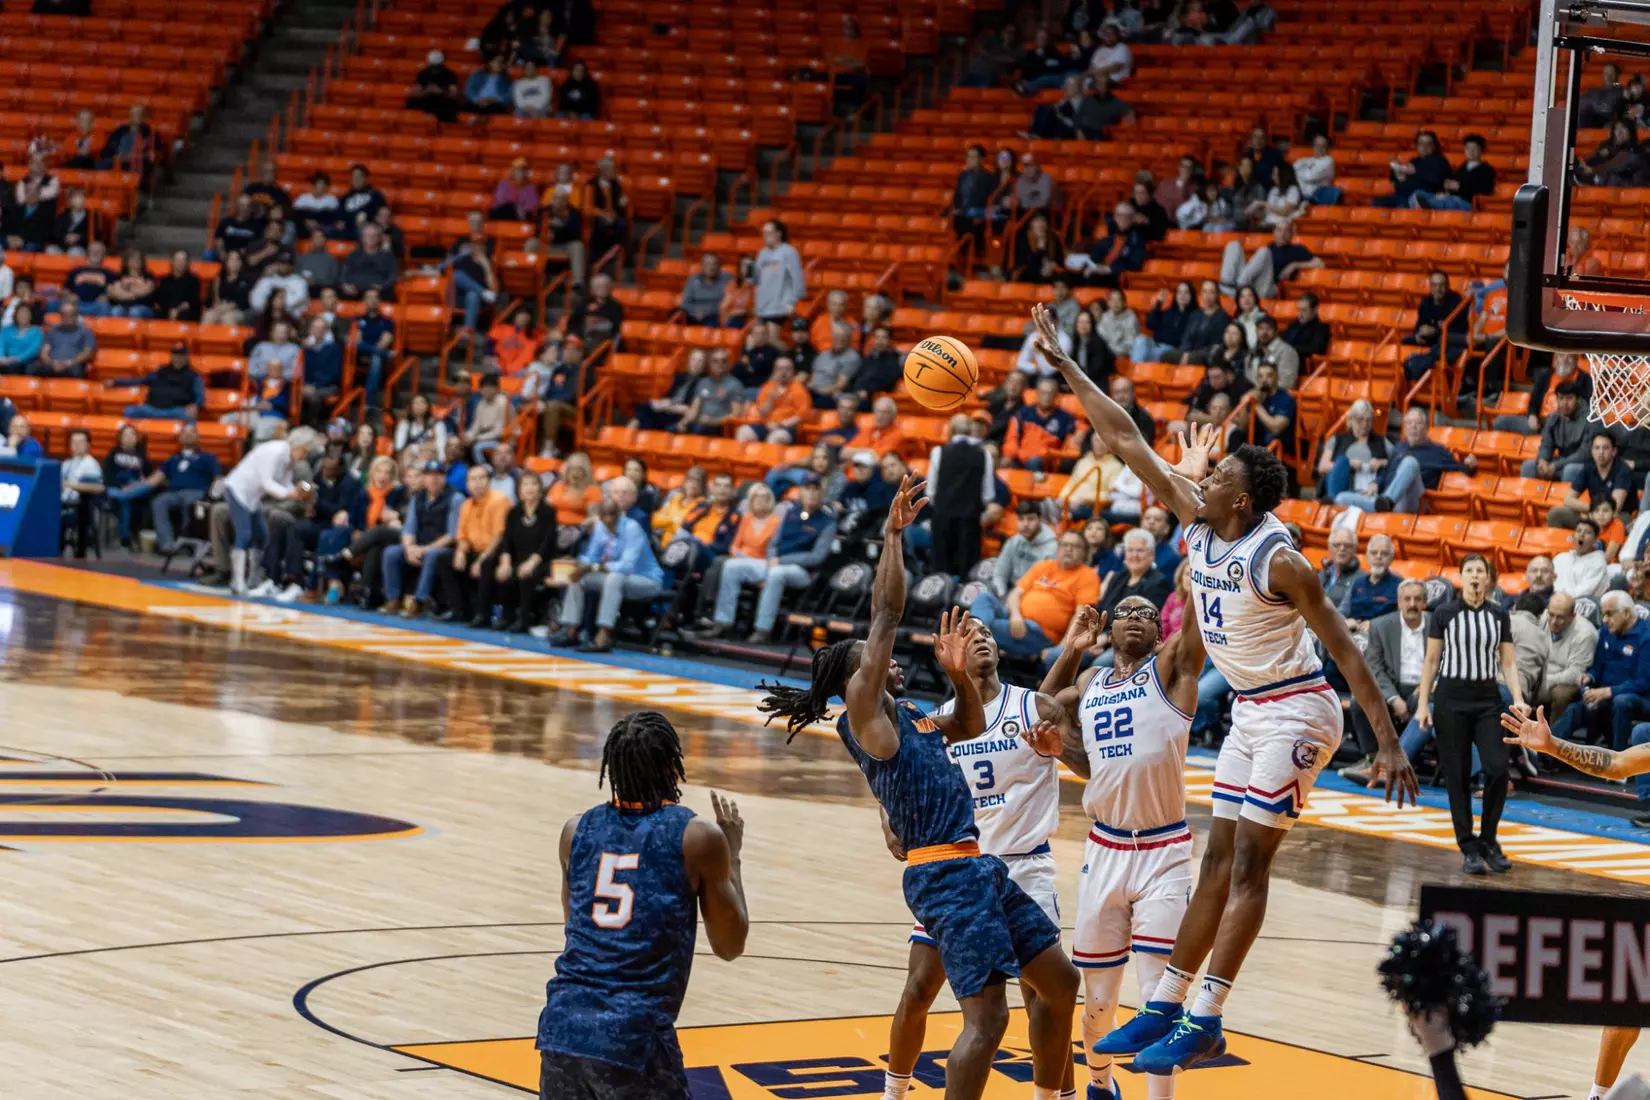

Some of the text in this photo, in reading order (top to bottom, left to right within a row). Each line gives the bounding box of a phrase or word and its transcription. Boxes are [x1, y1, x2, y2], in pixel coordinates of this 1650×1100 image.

[919, 340, 958, 368] Wilson
[1190, 568, 1241, 593] LOUISIANA
[1201, 592, 1224, 628] 14
[1203, 630, 1228, 645] TECH
[1085, 687, 1147, 709] LOUISIANA
[1094, 706, 1134, 741] 22
[954, 739, 1018, 757] OUISIANA
[1099, 743, 1133, 759] TECH
[1560, 743, 1605, 767] CHOSEN
[973, 760, 995, 790] 3
[592, 852, 640, 929] 5
